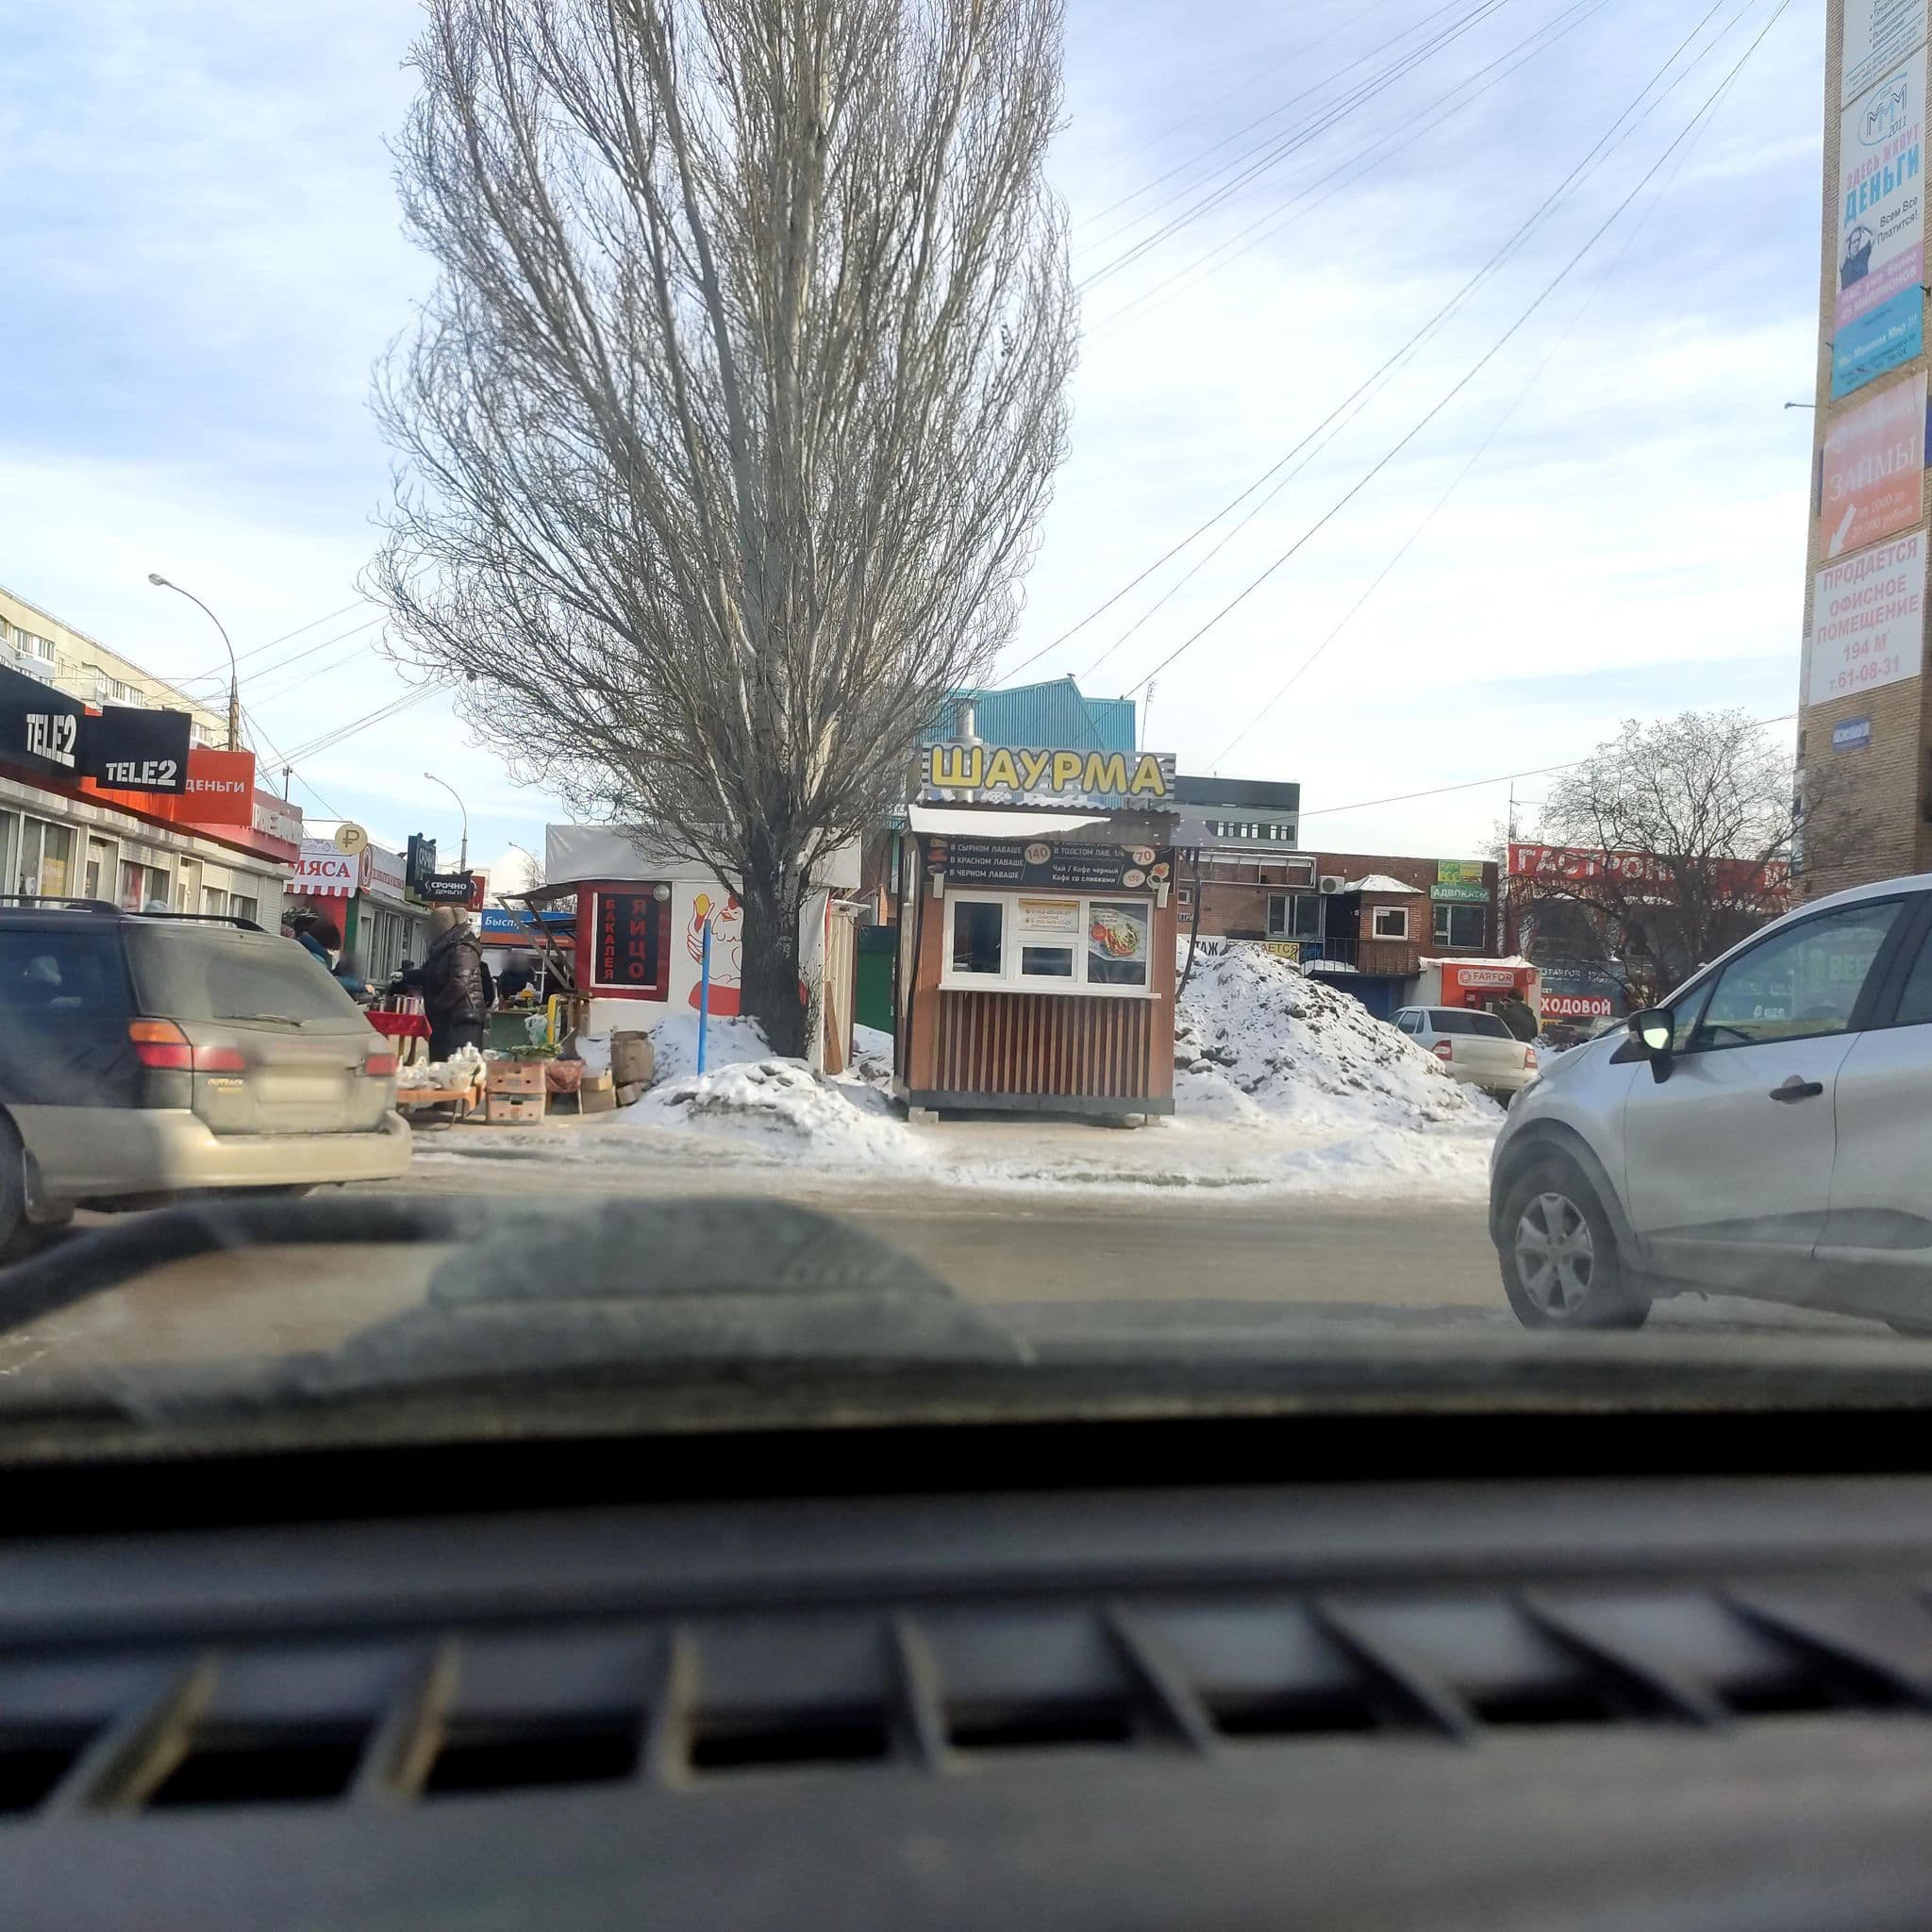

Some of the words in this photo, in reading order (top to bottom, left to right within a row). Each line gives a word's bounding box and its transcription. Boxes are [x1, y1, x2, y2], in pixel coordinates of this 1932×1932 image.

[1888, 116, 1907, 138] 2011
[1847, 154, 1880, 191] ЗДЕСЬ
[1883, 124, 1919, 163] ЖИВУТ
[1844, 143, 1920, 228] ДЕНЬГИ
[1876, 209, 1918, 245] Платится!
[1829, 438, 1917, 501] ЗАЙМЫ
[1823, 538, 1918, 592] ПРОДАЕТСЯ
[1830, 575, 1907, 616] ОФИСНОЕ
[1817, 594, 1919, 645] ПОМЕЩЕНИЕ
[1843, 638, 1870, 662] 194
[26, 713, 77, 768] TELE2
[106, 759, 177, 787] TELE2
[931, 744, 1167, 798] ШАУРМА
[186, 779, 245, 793] ДЕНЬГИ
[958, 844, 990, 853] СЫРНОМ
[1027, 848, 1048, 859] 140
[1137, 851, 1152, 862] 70
[958, 857, 991, 865] КРАСНОМ
[993, 858, 1024, 867] ЛАВАШЕ
[1074, 865, 1090, 874] Кофе
[958, 869, 987, 877] ЧЕРНОМ
[989, 871, 1020, 879] ЛАВАШЕ
[1053, 874, 1070, 883] Кофе
[485, 916, 521, 929] Быст
[604, 899, 616, 979] БАКАЛЕЯ
[1473, 972, 1512, 983] FARFOR
[1548, 968, 1581, 977] FARFOR
[1541, 998, 1611, 1016] ХОДОВОЙ
